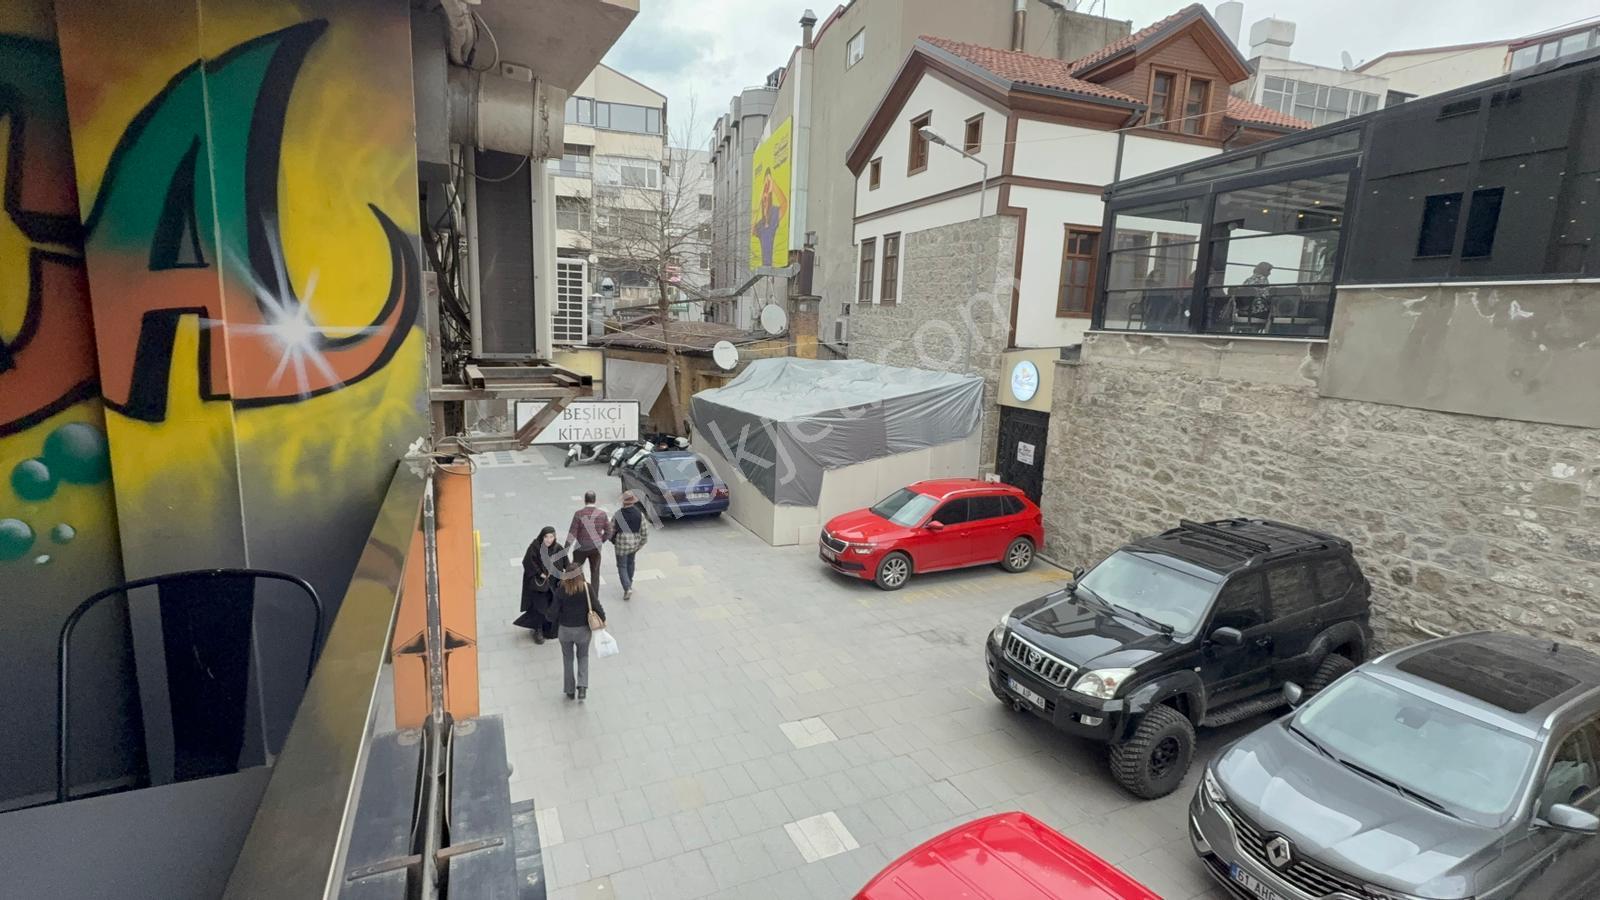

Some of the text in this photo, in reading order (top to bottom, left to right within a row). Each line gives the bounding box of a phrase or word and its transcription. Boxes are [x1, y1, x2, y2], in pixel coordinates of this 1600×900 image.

[563, 405, 622, 424] BEŞİKÇİ
[558, 424, 626, 441] KİTABEVİ
[1238, 869, 1249, 886] 61
